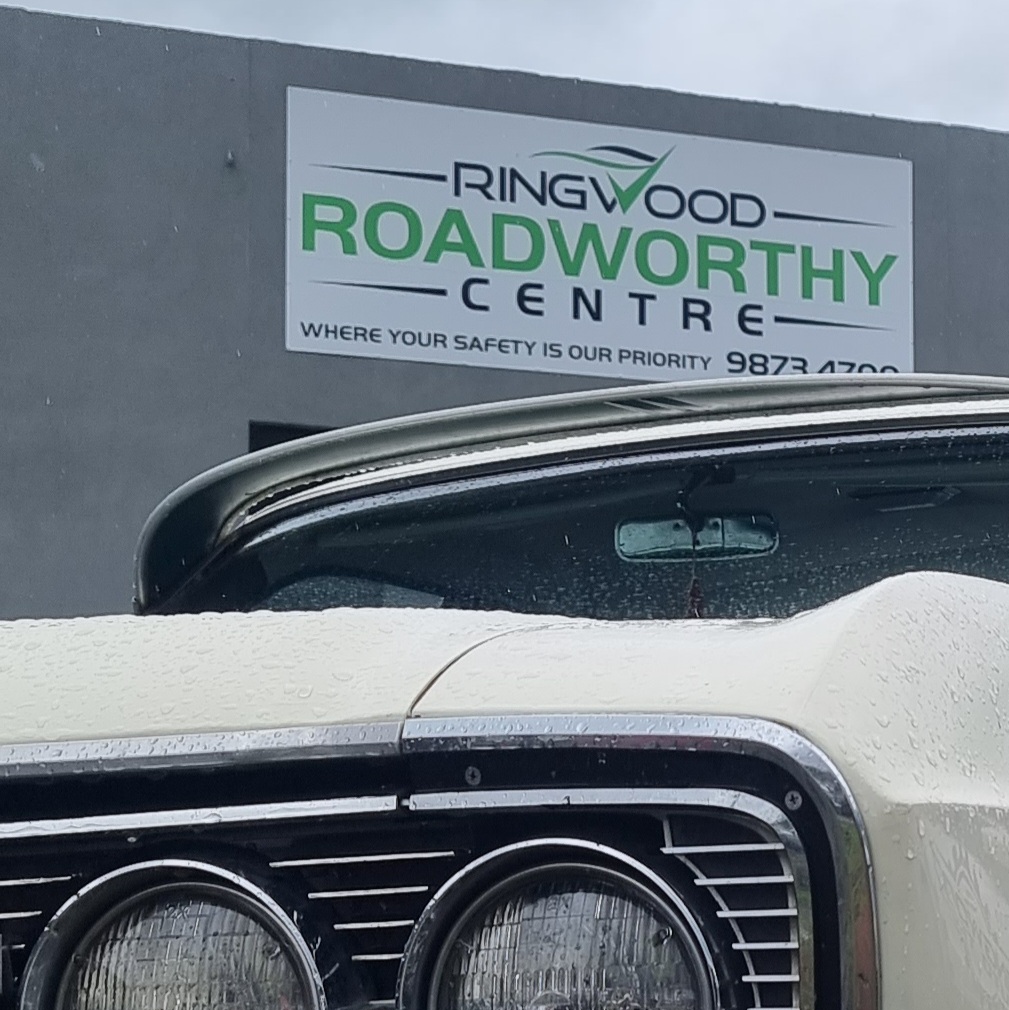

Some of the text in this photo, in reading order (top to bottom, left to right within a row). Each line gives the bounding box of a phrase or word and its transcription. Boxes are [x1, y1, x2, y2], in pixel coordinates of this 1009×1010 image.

[453, 160, 767, 228] RINGWOOD
[301, 192, 898, 306] ROADWORTHY
[461, 277, 764, 337] CENTRE
[300, 321, 382, 343] WHERE
[388, 328, 448, 348] YOUR
[453, 334, 537, 356] SAFETY
[543, 342, 563, 359] IS
[568, 345, 613, 363] OUR
[618, 348, 712, 371] PRIORITY
[726, 351, 808, 375] 9873
